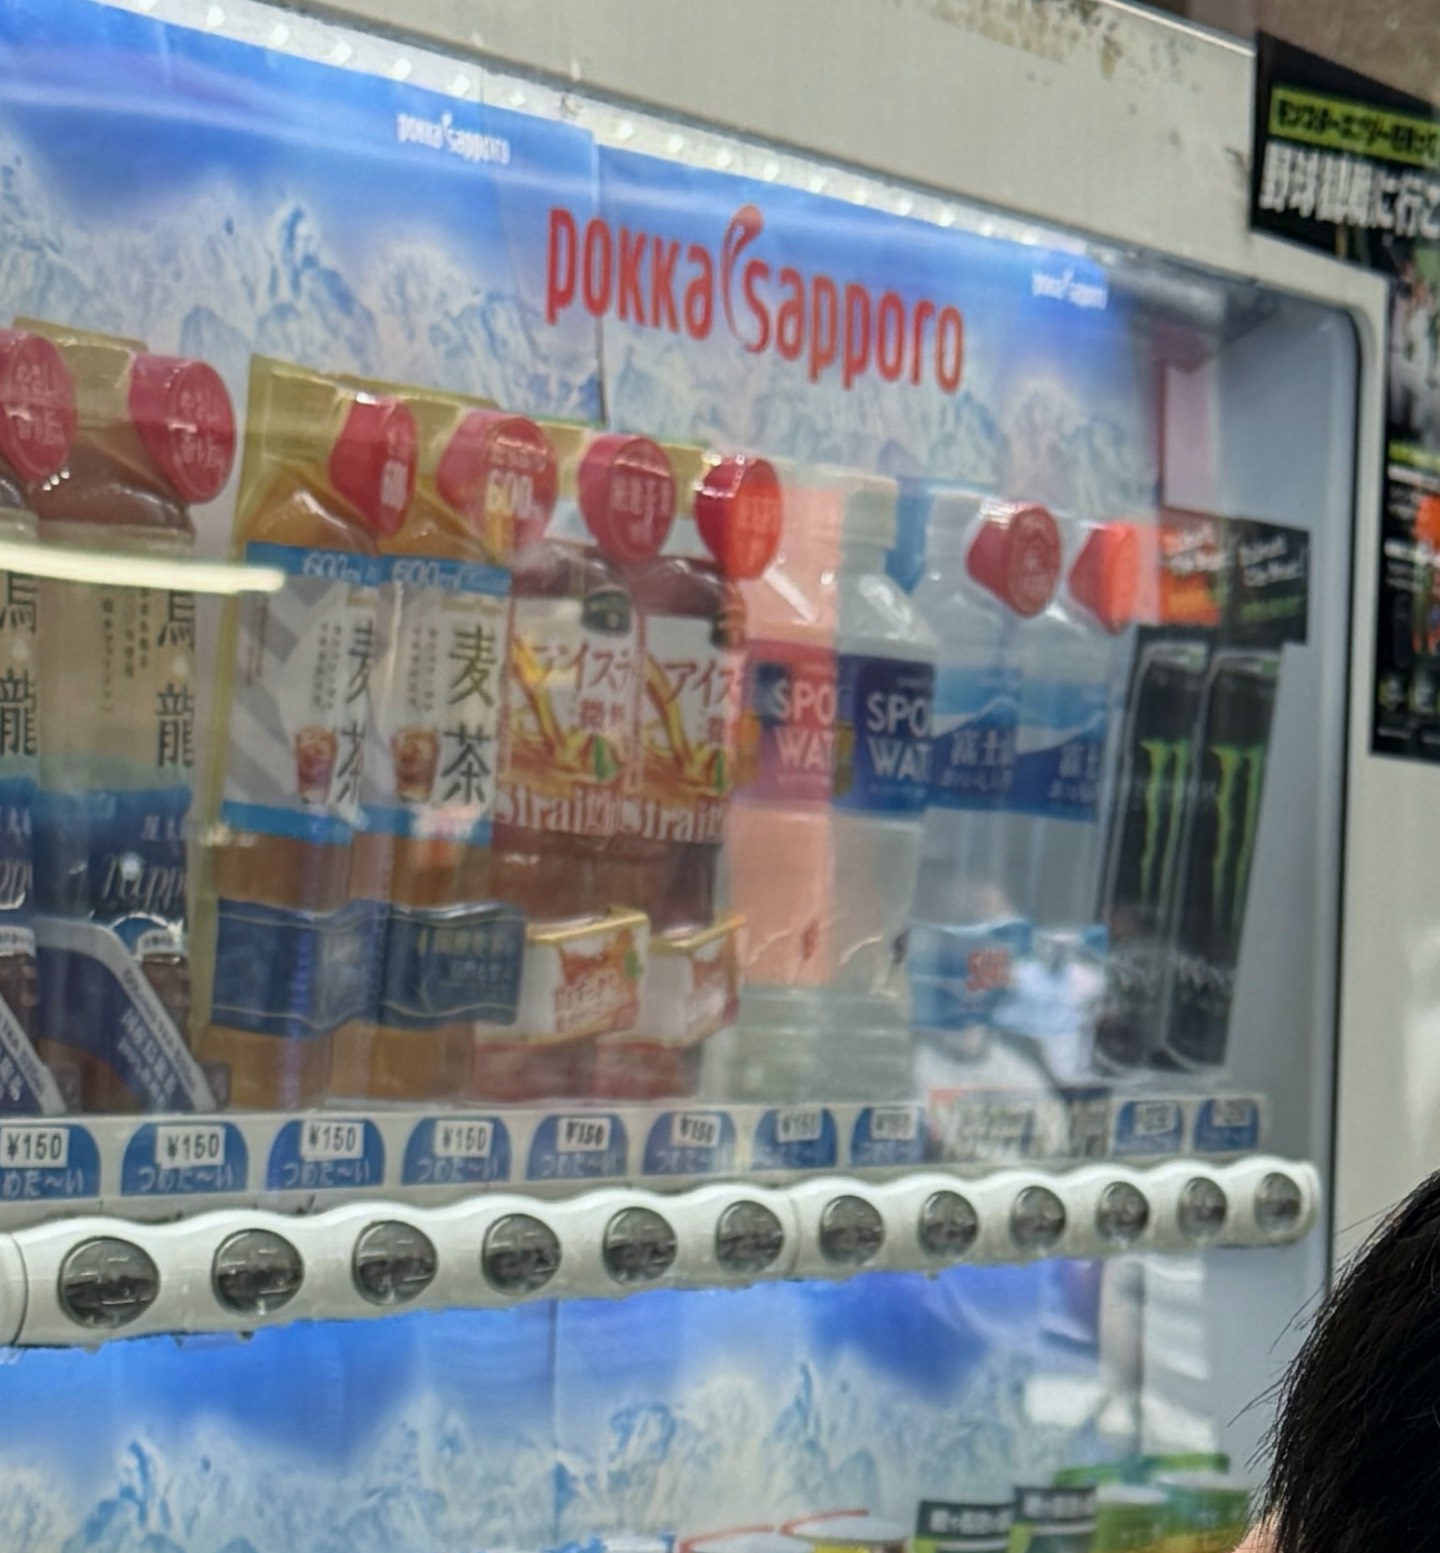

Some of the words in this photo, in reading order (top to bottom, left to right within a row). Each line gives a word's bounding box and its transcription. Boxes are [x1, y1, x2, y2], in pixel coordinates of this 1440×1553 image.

[447, 622, 497, 804] 麦茶
[6, 1132, 63, 1161] ¥150
[166, 1133, 221, 1163] ¥150
[308, 1124, 357, 1154] ¥150
[441, 1123, 487, 1153] ¥150
